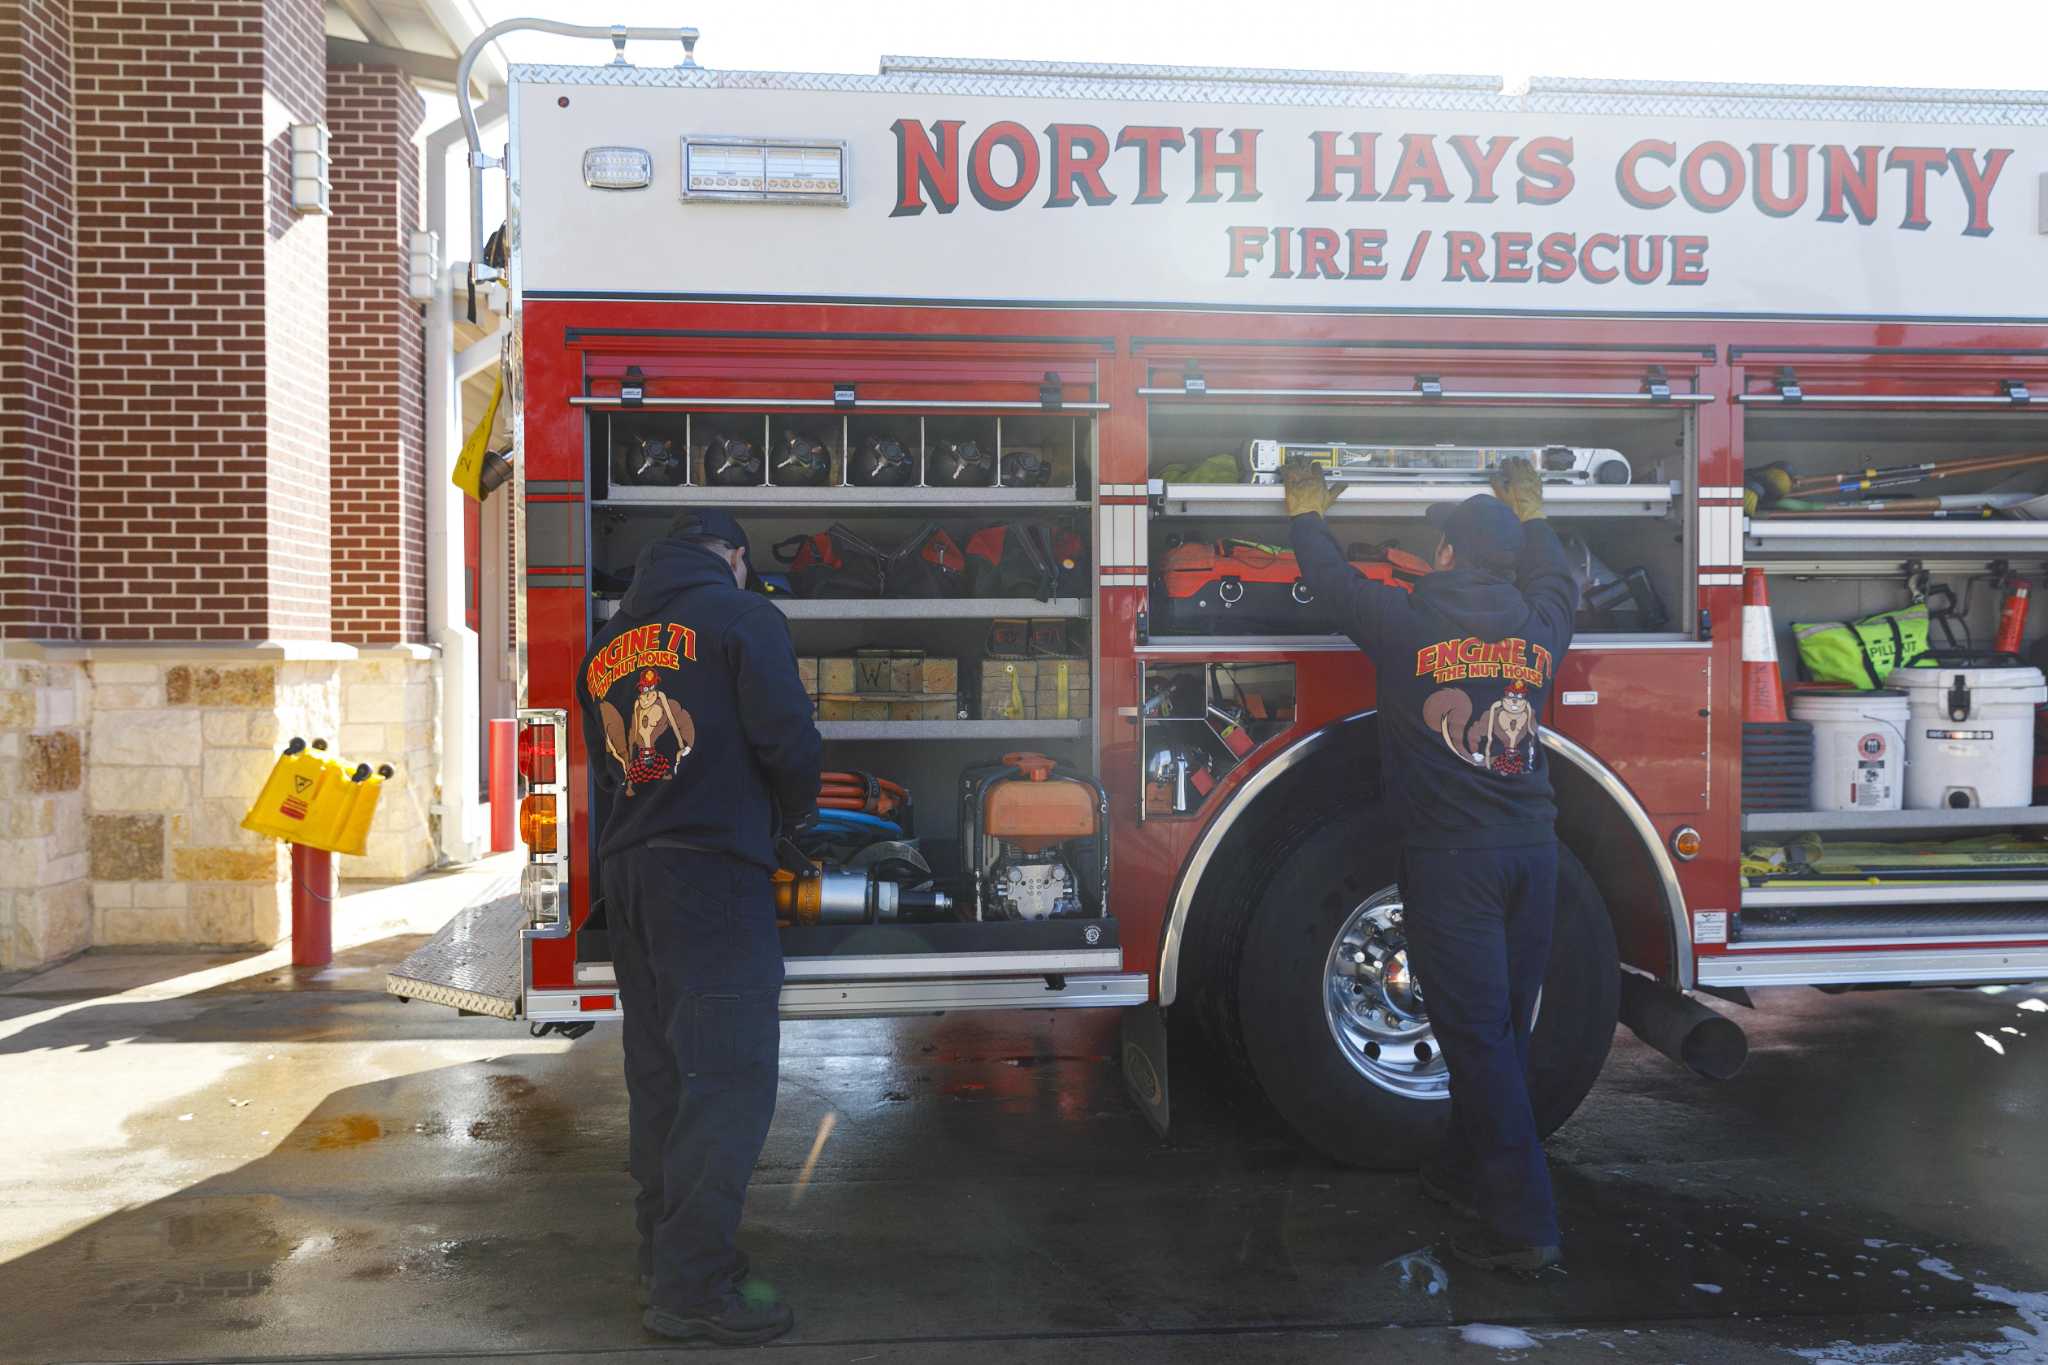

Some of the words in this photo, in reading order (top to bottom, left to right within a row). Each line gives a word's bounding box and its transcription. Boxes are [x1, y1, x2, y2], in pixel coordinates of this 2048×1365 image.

[888, 119, 1264, 218] NORTH
[1307, 129, 1576, 206] HAYS
[1615, 138, 2014, 238] COUNTY
[588, 624, 661, 701] ENGINE
[668, 623, 696, 661] 71
[614, 656, 637, 681] NUT
[638, 651, 679, 670] HOUSE
[1416, 637, 1527, 676] ENGINE
[1869, 643, 1896, 658] PILL
[1434, 664, 1467, 684] THE
[1469, 663, 1500, 678] NUT
